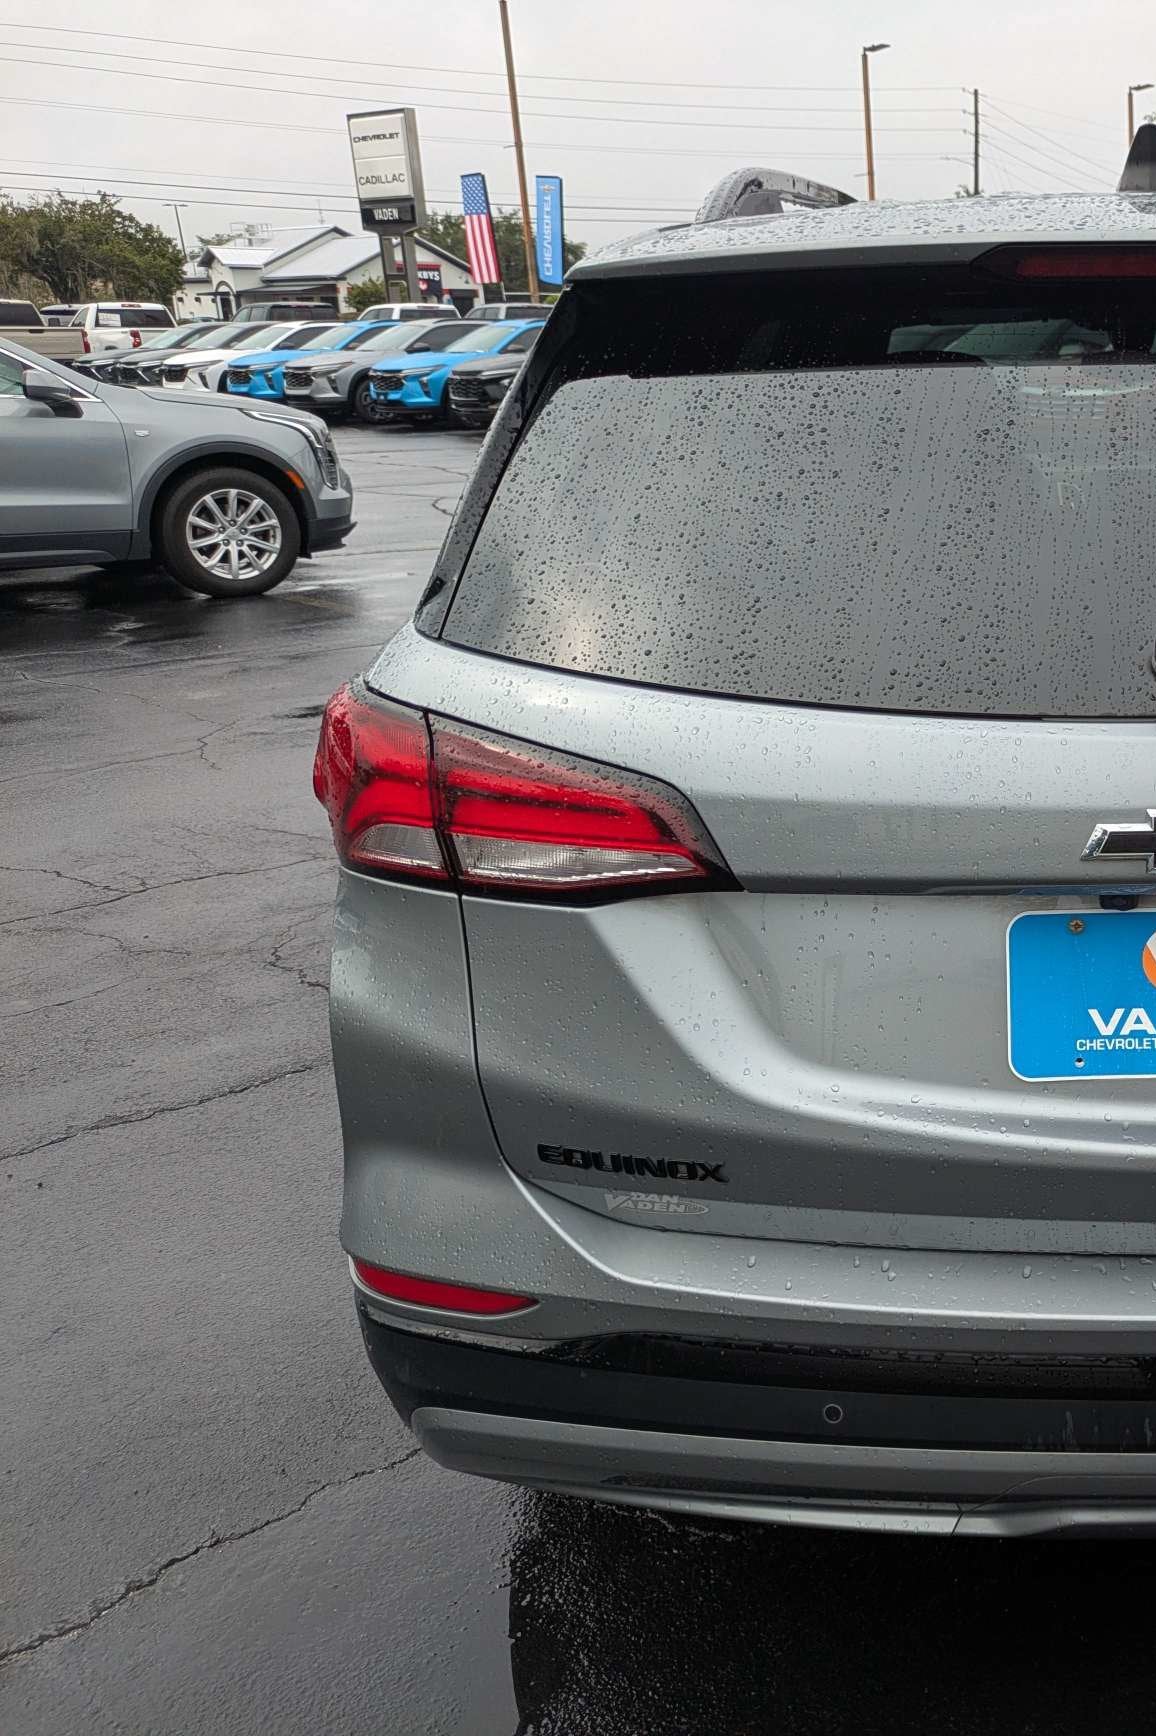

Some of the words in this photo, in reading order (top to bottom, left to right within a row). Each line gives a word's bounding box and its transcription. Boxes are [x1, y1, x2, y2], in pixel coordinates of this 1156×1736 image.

[353, 132, 400, 143] CHEVROLET
[359, 173, 405, 186] CADILLAC
[373, 208, 400, 221] VADEN
[537, 1143, 730, 1184] EQUINOX
